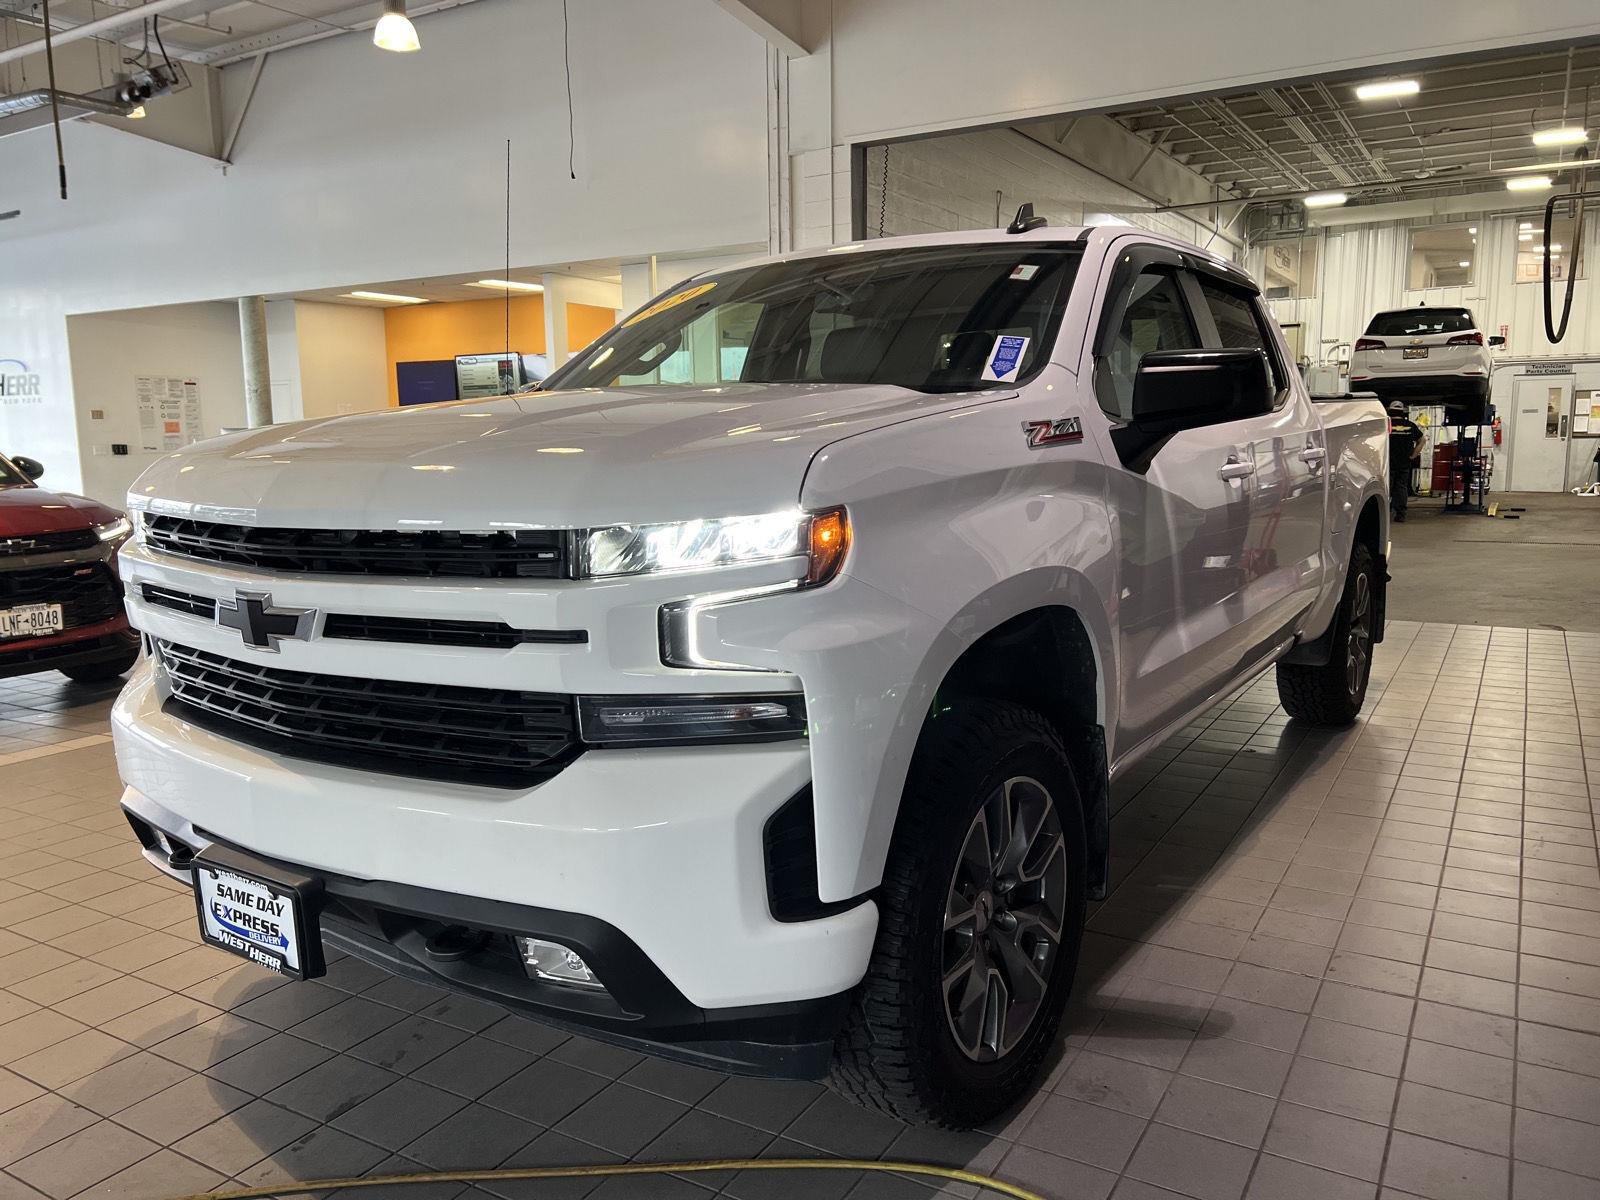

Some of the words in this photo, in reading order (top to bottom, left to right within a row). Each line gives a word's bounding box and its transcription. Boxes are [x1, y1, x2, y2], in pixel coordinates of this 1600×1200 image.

[217, 883, 255, 908] SAME
[256, 896, 285, 917] DAY
[213, 902, 280, 937] EXPRESS
[249, 932, 281, 945] DELIVERY
